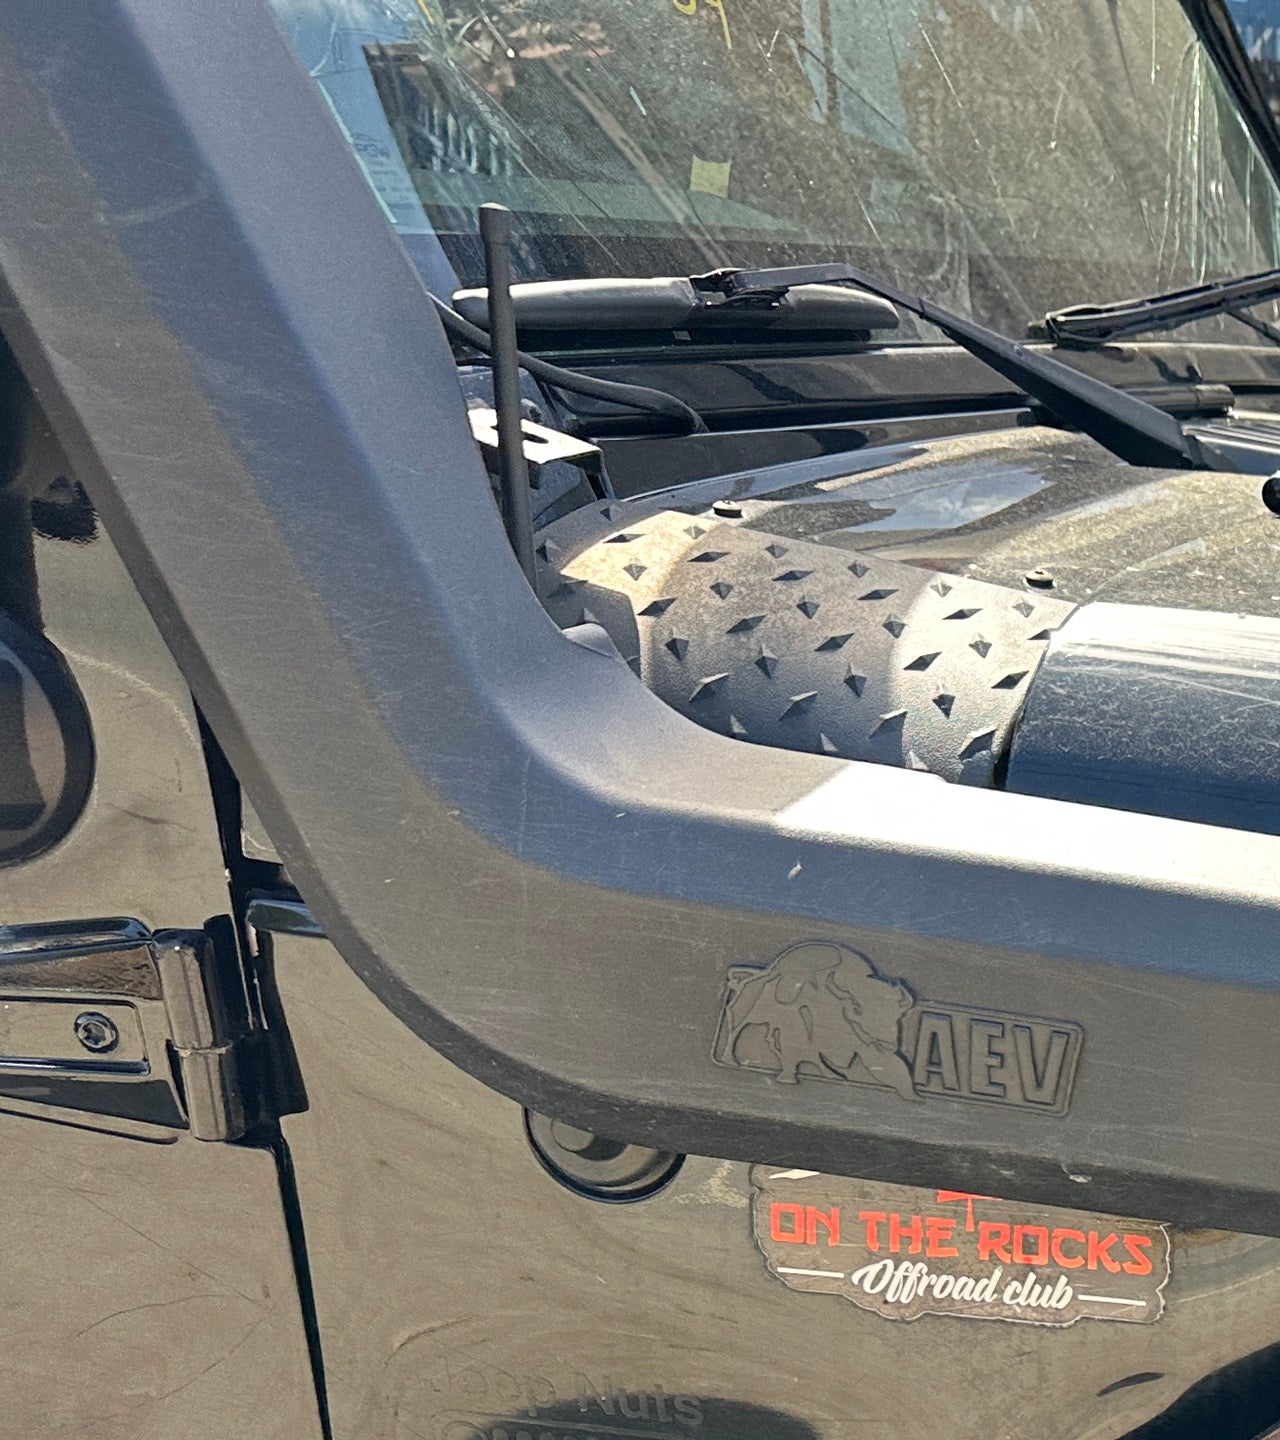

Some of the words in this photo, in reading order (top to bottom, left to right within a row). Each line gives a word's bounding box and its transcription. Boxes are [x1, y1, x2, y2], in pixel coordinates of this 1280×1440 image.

[914, 1010, 1074, 1107] AEV
[769, 1203, 840, 1247] ON
[858, 1210, 960, 1258] THE
[977, 1220, 1153, 1276] ROCKS
[851, 1258, 1002, 1304] Offroad
[1000, 1270, 1074, 1310] club
[575, 1372, 705, 1426] Nuts
